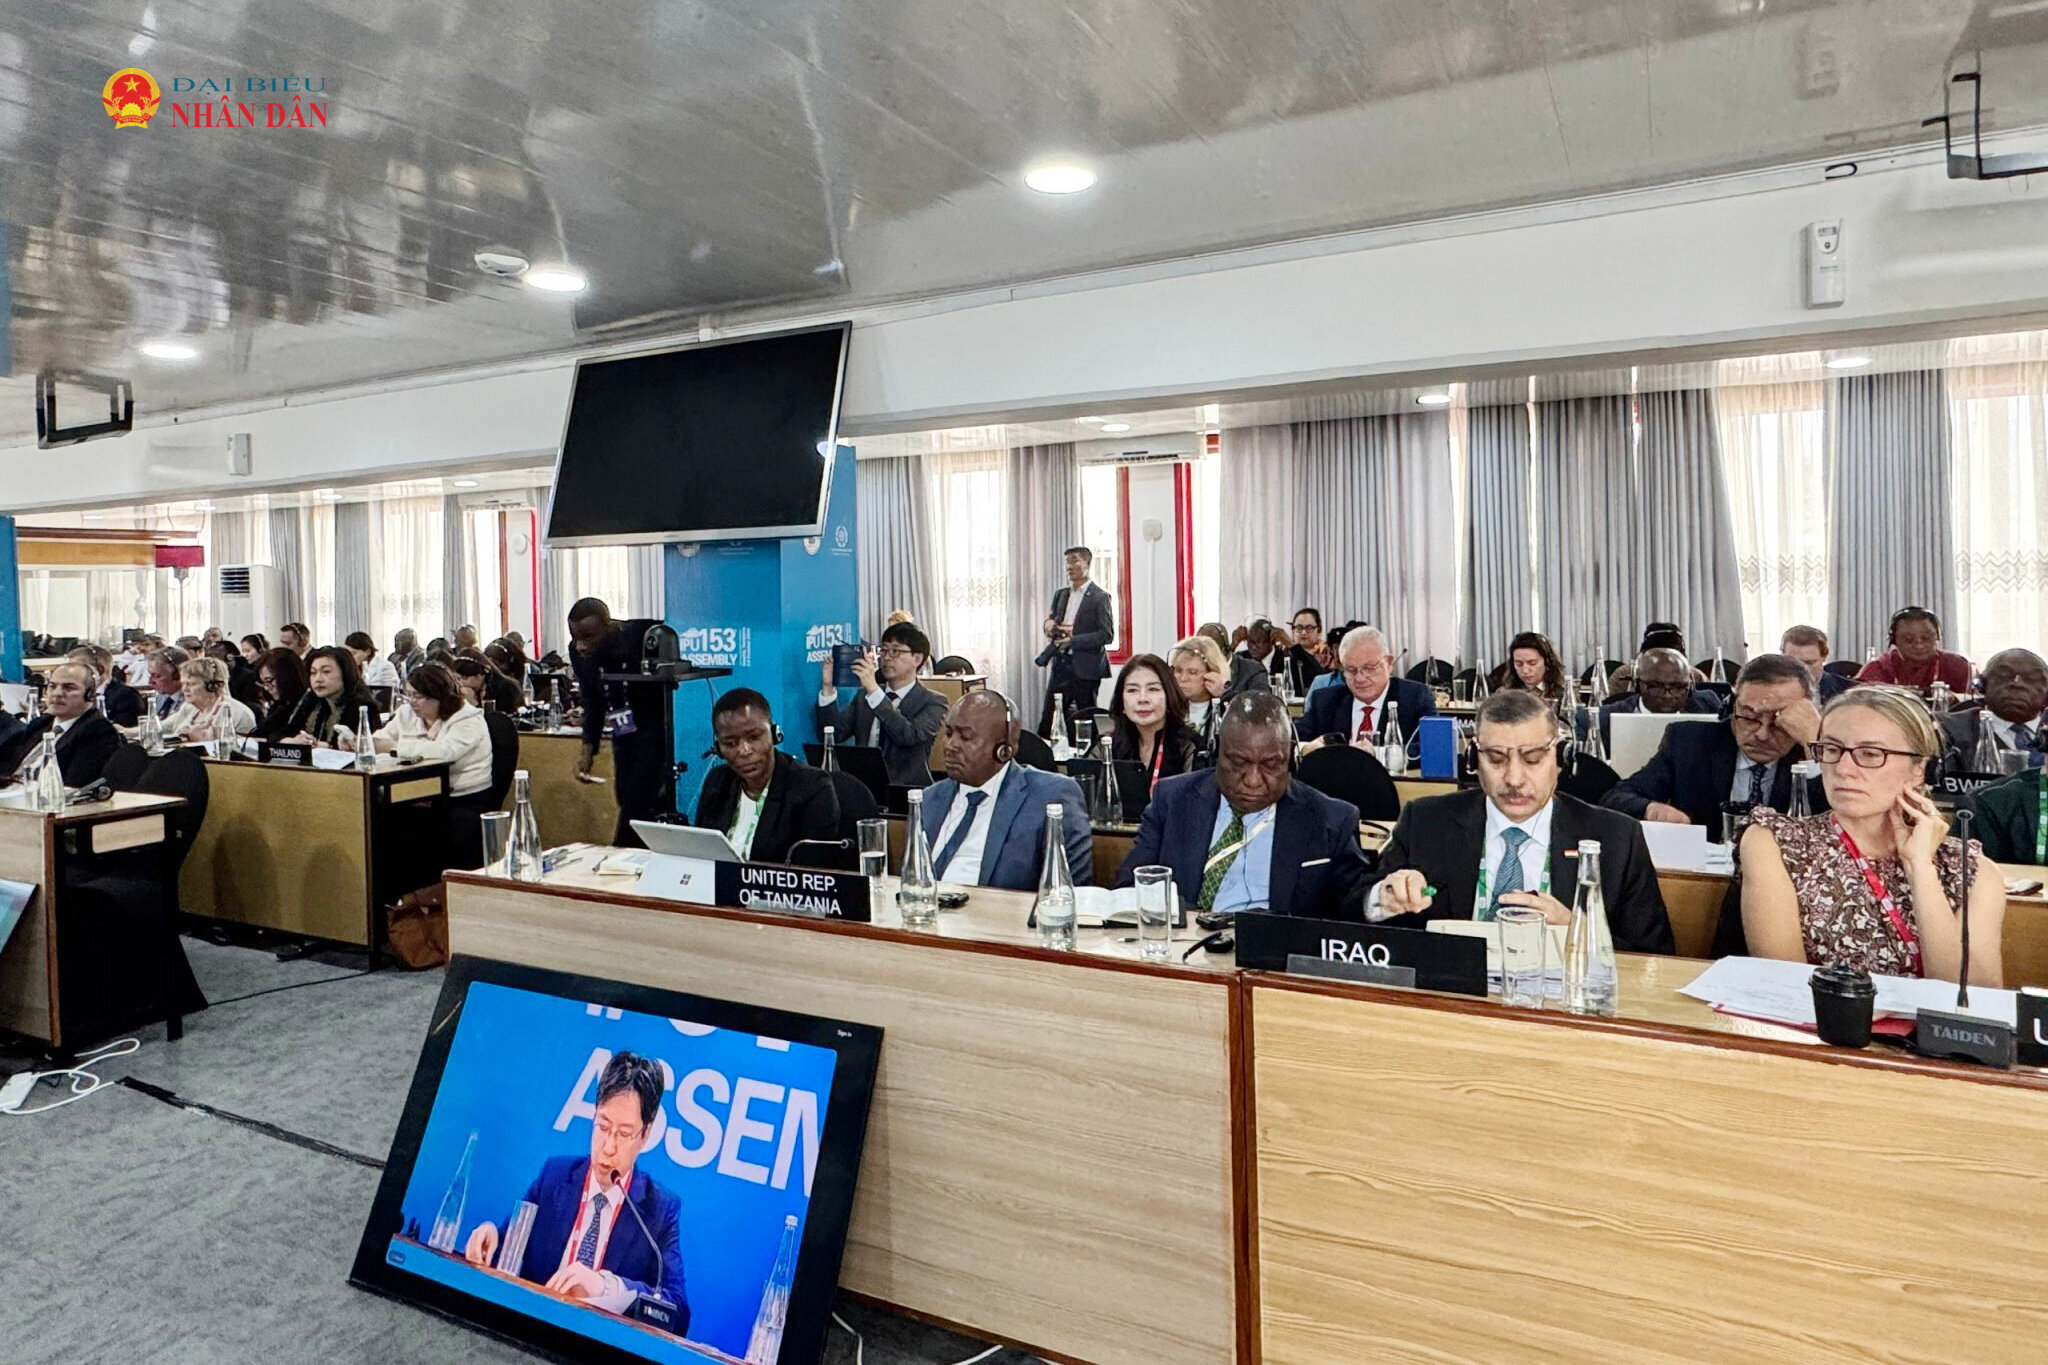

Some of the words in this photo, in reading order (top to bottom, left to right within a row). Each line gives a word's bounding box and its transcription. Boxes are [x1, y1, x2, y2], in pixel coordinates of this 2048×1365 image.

[680, 653, 738, 667] ASSEMBLY
[269, 747, 302, 759] THAILAND
[741, 867, 798, 888] UNITED
[802, 874, 838, 893] REP.
[739, 888, 760, 906] OF
[765, 891, 842, 916] TANZANIA
[1320, 938, 1390, 969] IRAQ
[1931, 1024, 1996, 1047] TAIDEN
